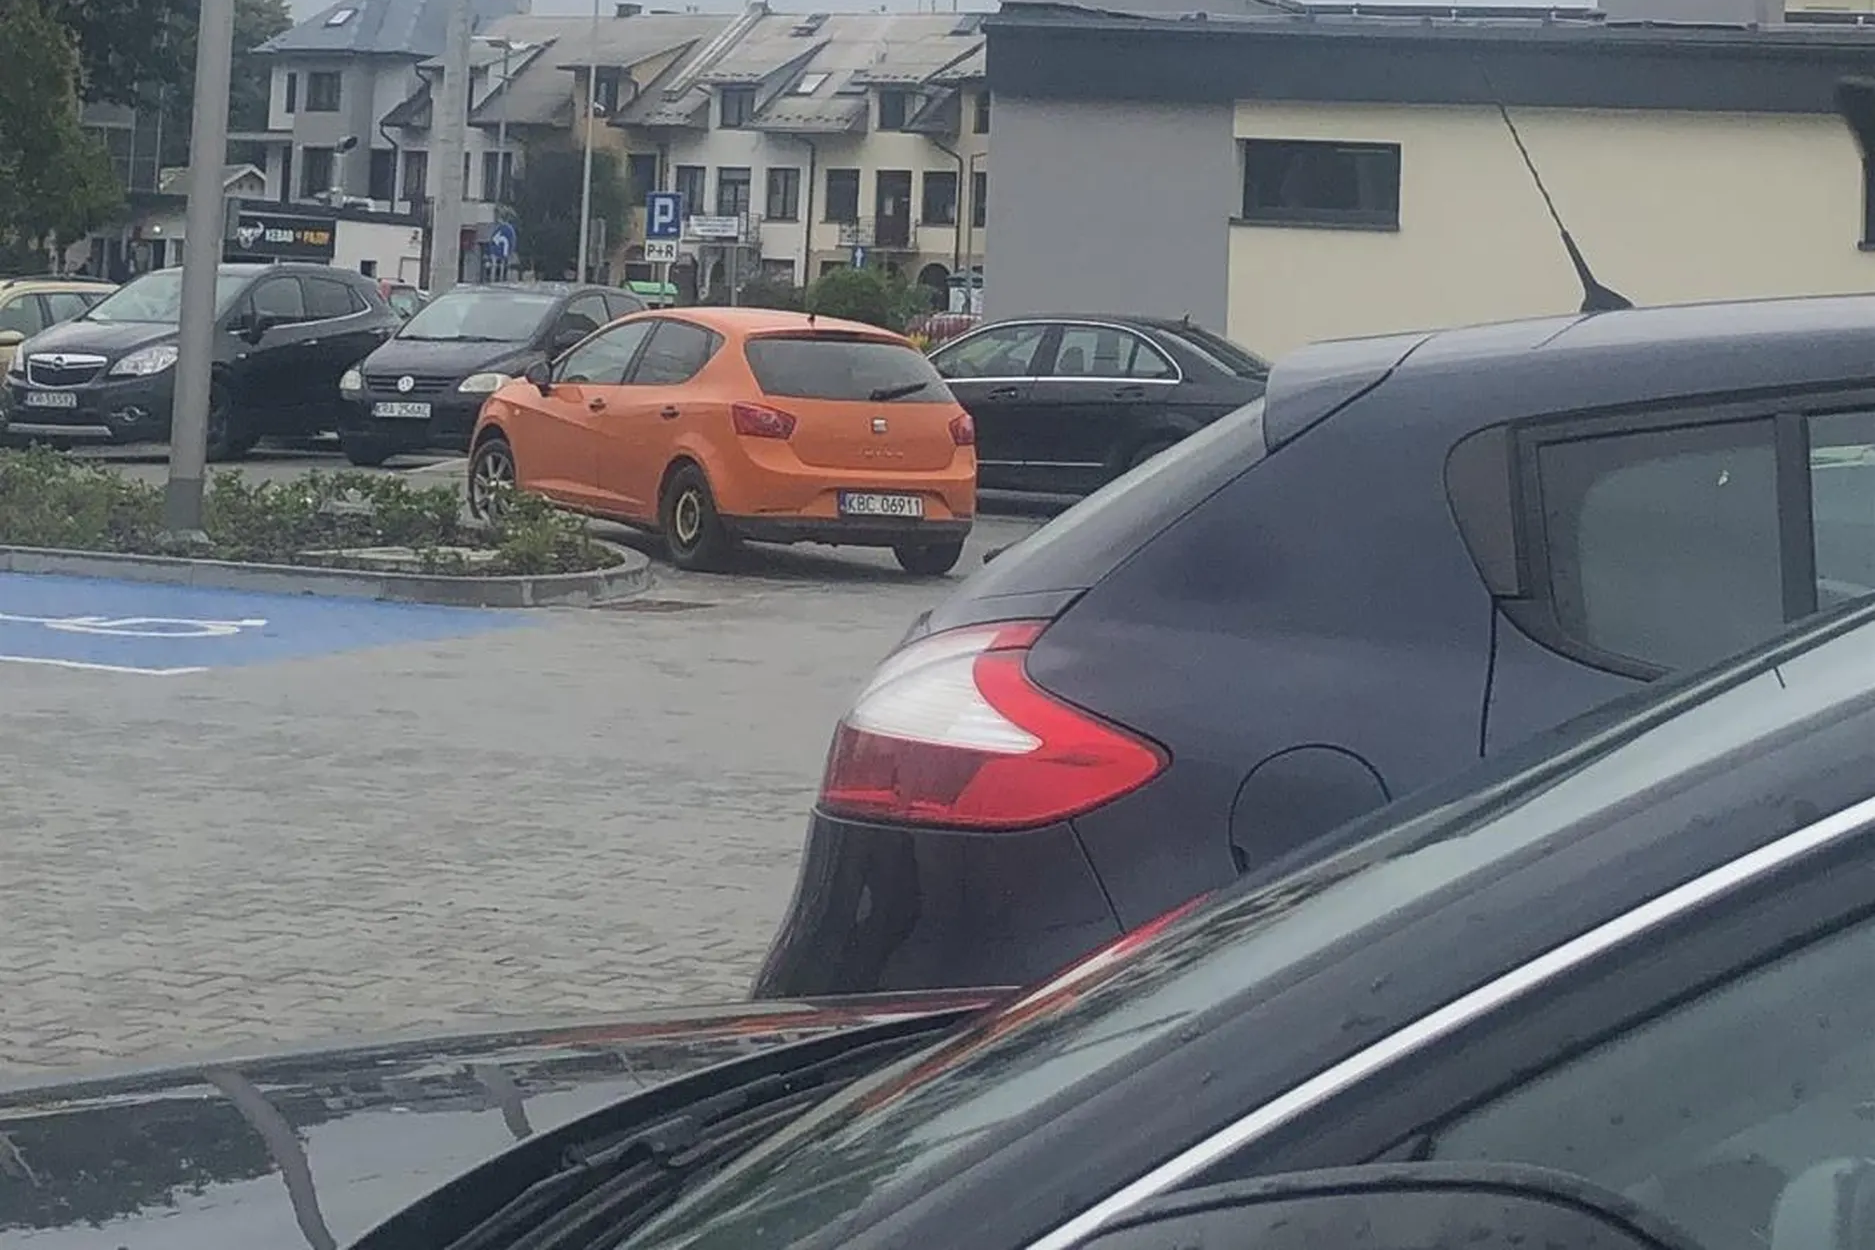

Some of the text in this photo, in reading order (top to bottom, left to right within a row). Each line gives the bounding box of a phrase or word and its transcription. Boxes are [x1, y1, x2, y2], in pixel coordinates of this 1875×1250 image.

[653, 197, 674, 233] P
[265, 229, 294, 243] KEBAB
[647, 244, 674, 257] P+R
[848, 496, 920, 514] KBC 06911
